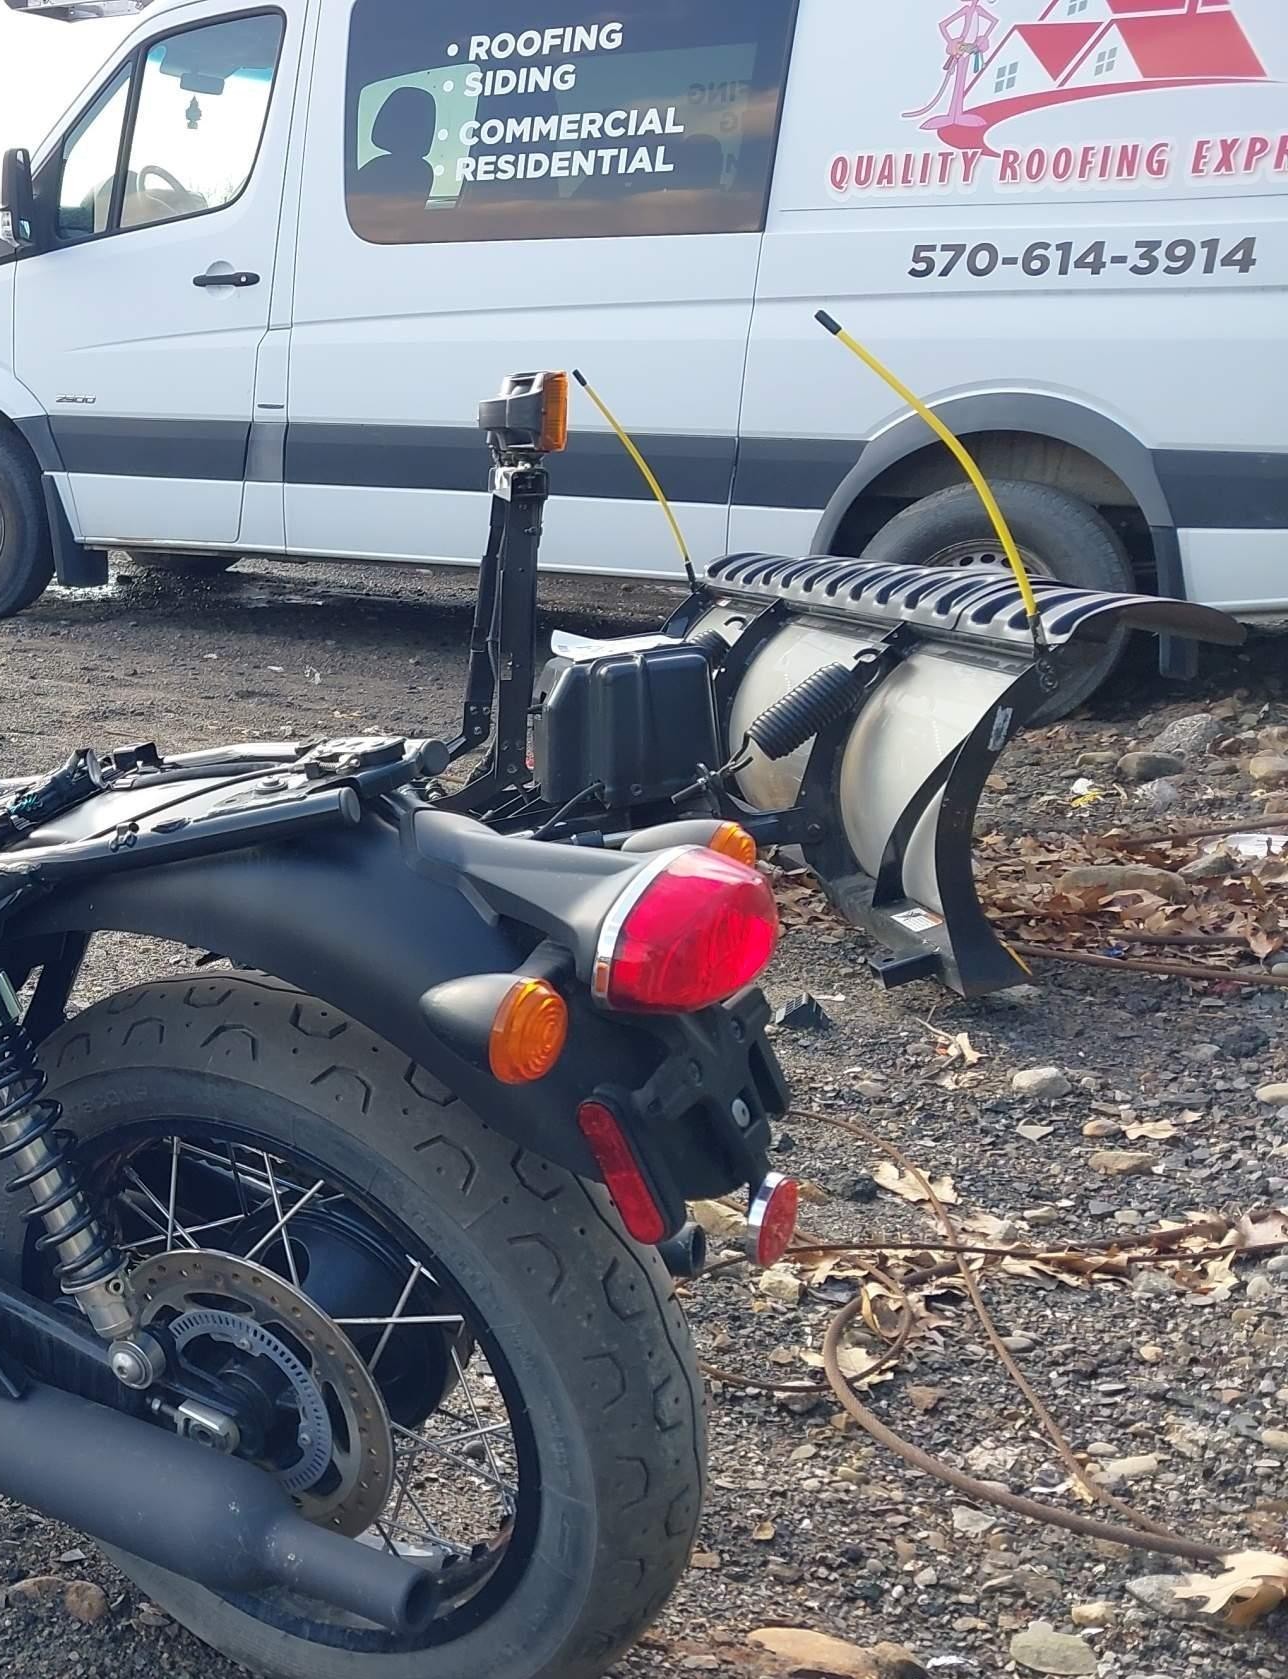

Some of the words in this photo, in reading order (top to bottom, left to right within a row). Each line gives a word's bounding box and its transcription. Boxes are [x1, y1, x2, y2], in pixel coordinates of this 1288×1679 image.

[468, 22, 623, 61] ROOFING
[463, 64, 576, 97] SIDING
[459, 107, 685, 145] COMMERCIAL
[455, 146, 675, 182] RESIDENTIAL
[830, 150, 983, 191] QUALITY
[999, 142, 1169, 183] ROOFING
[907, 236, 1257, 279] 570-614-3914
